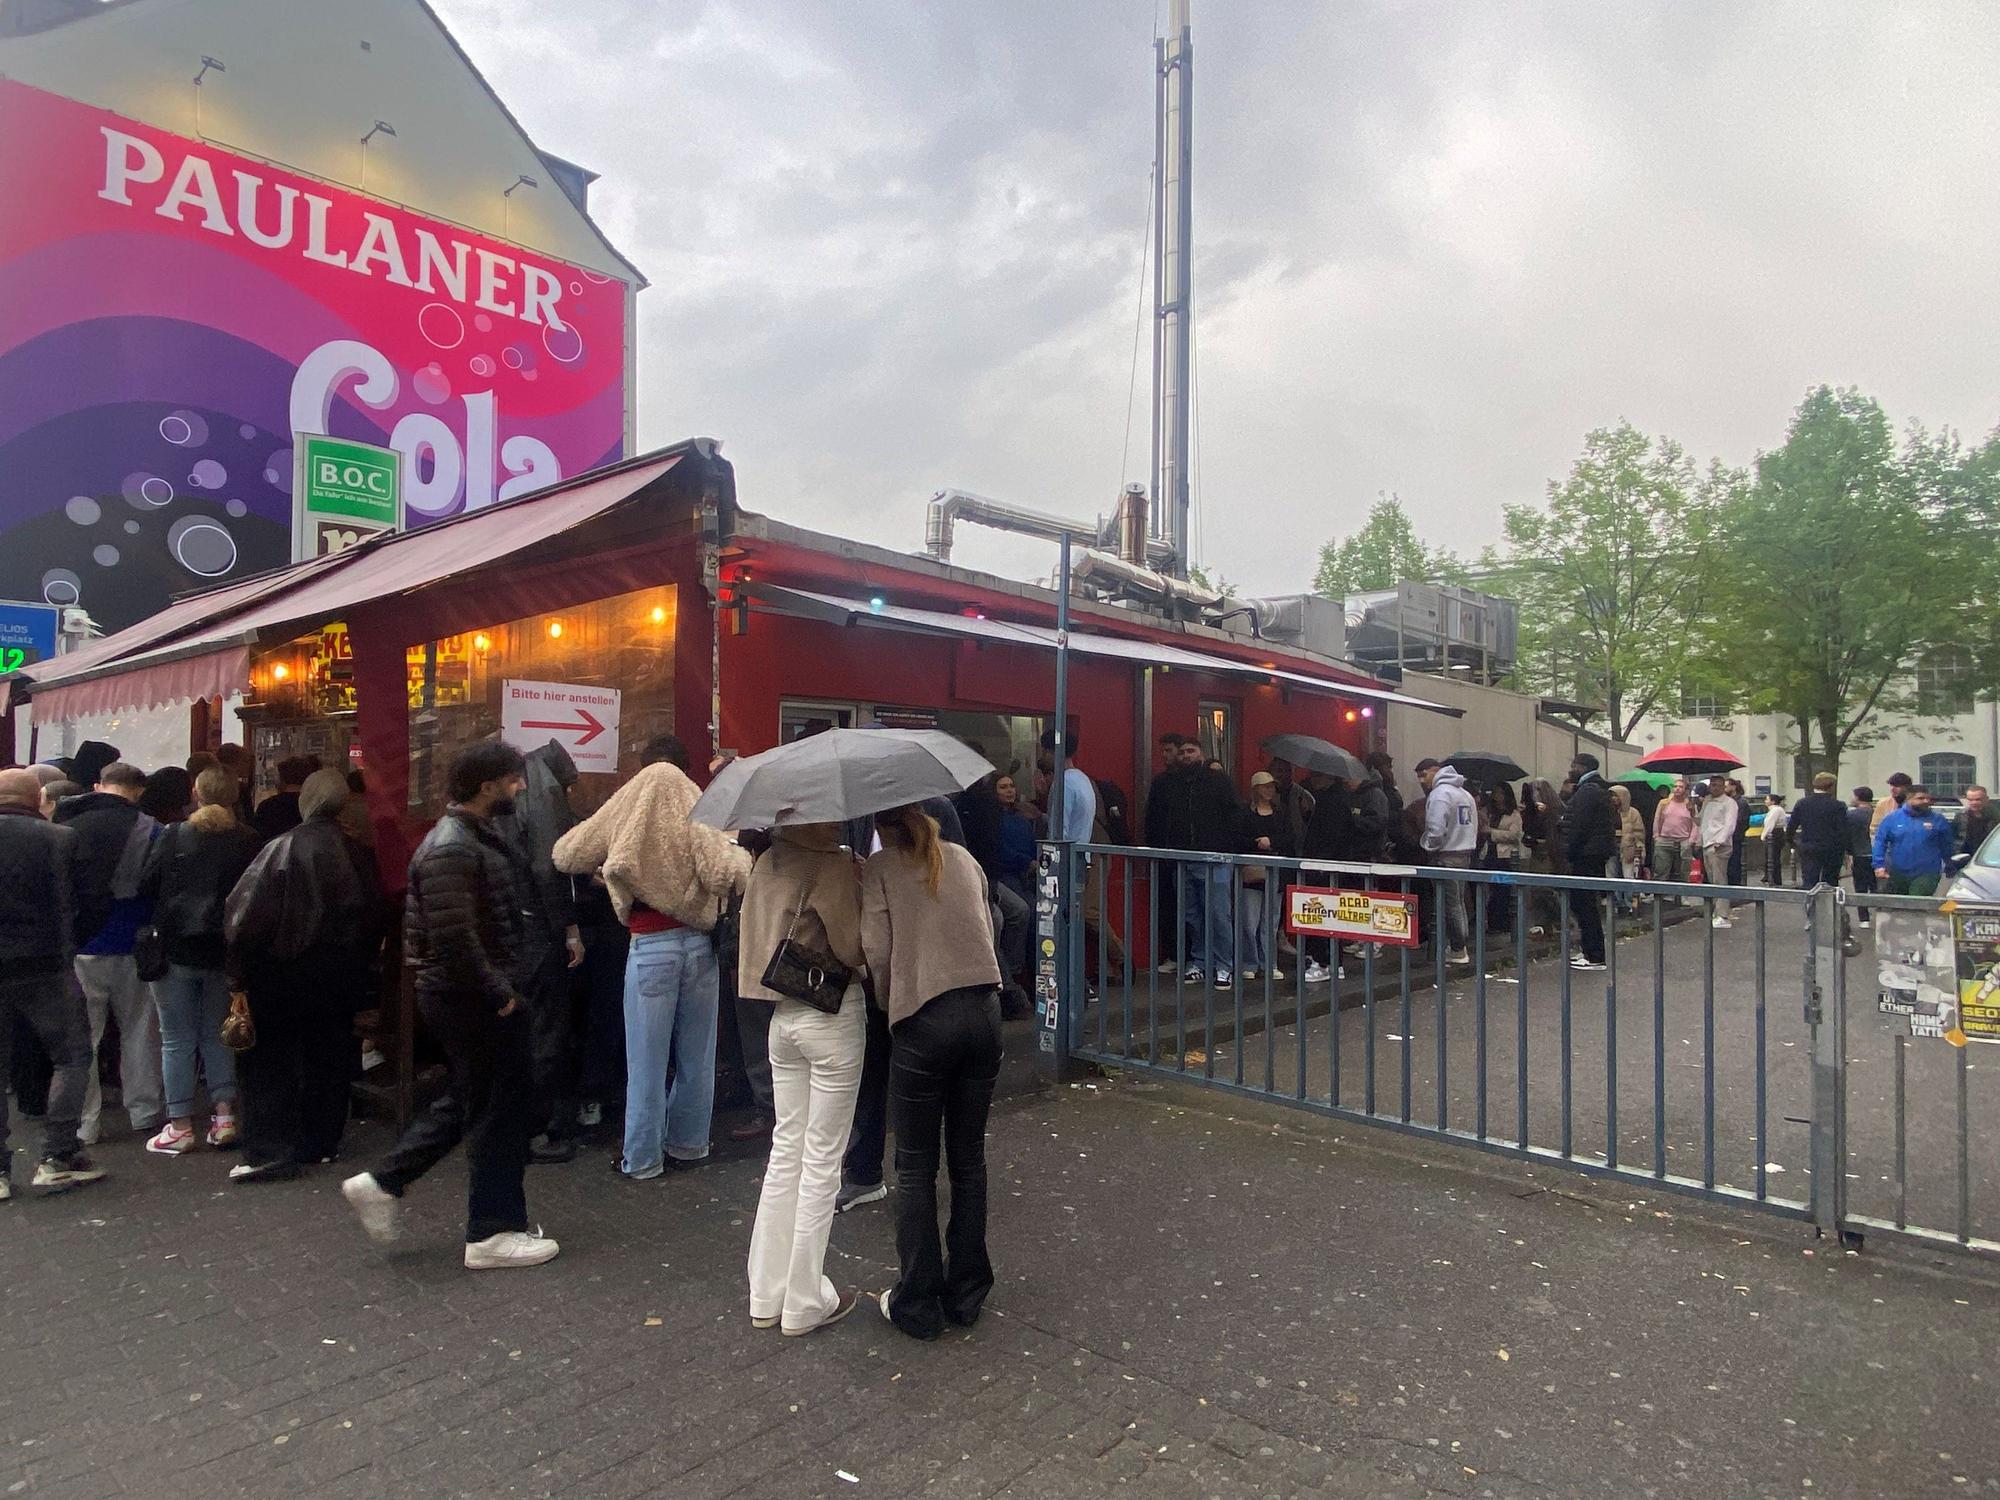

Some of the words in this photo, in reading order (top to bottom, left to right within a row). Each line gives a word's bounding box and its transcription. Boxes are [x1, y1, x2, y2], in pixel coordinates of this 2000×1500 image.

[98, 126, 567, 332] PAULANER
[290, 340, 558, 514] Cola
[320, 462, 387, 493] B.O.C.
[512, 688, 540, 700] Bitte
[544, 690, 566, 701] hier
[569, 694, 614, 705] anstellen
[1340, 897, 1369, 908] ACAB
[1338, 910, 1371, 922] ULTRAS
